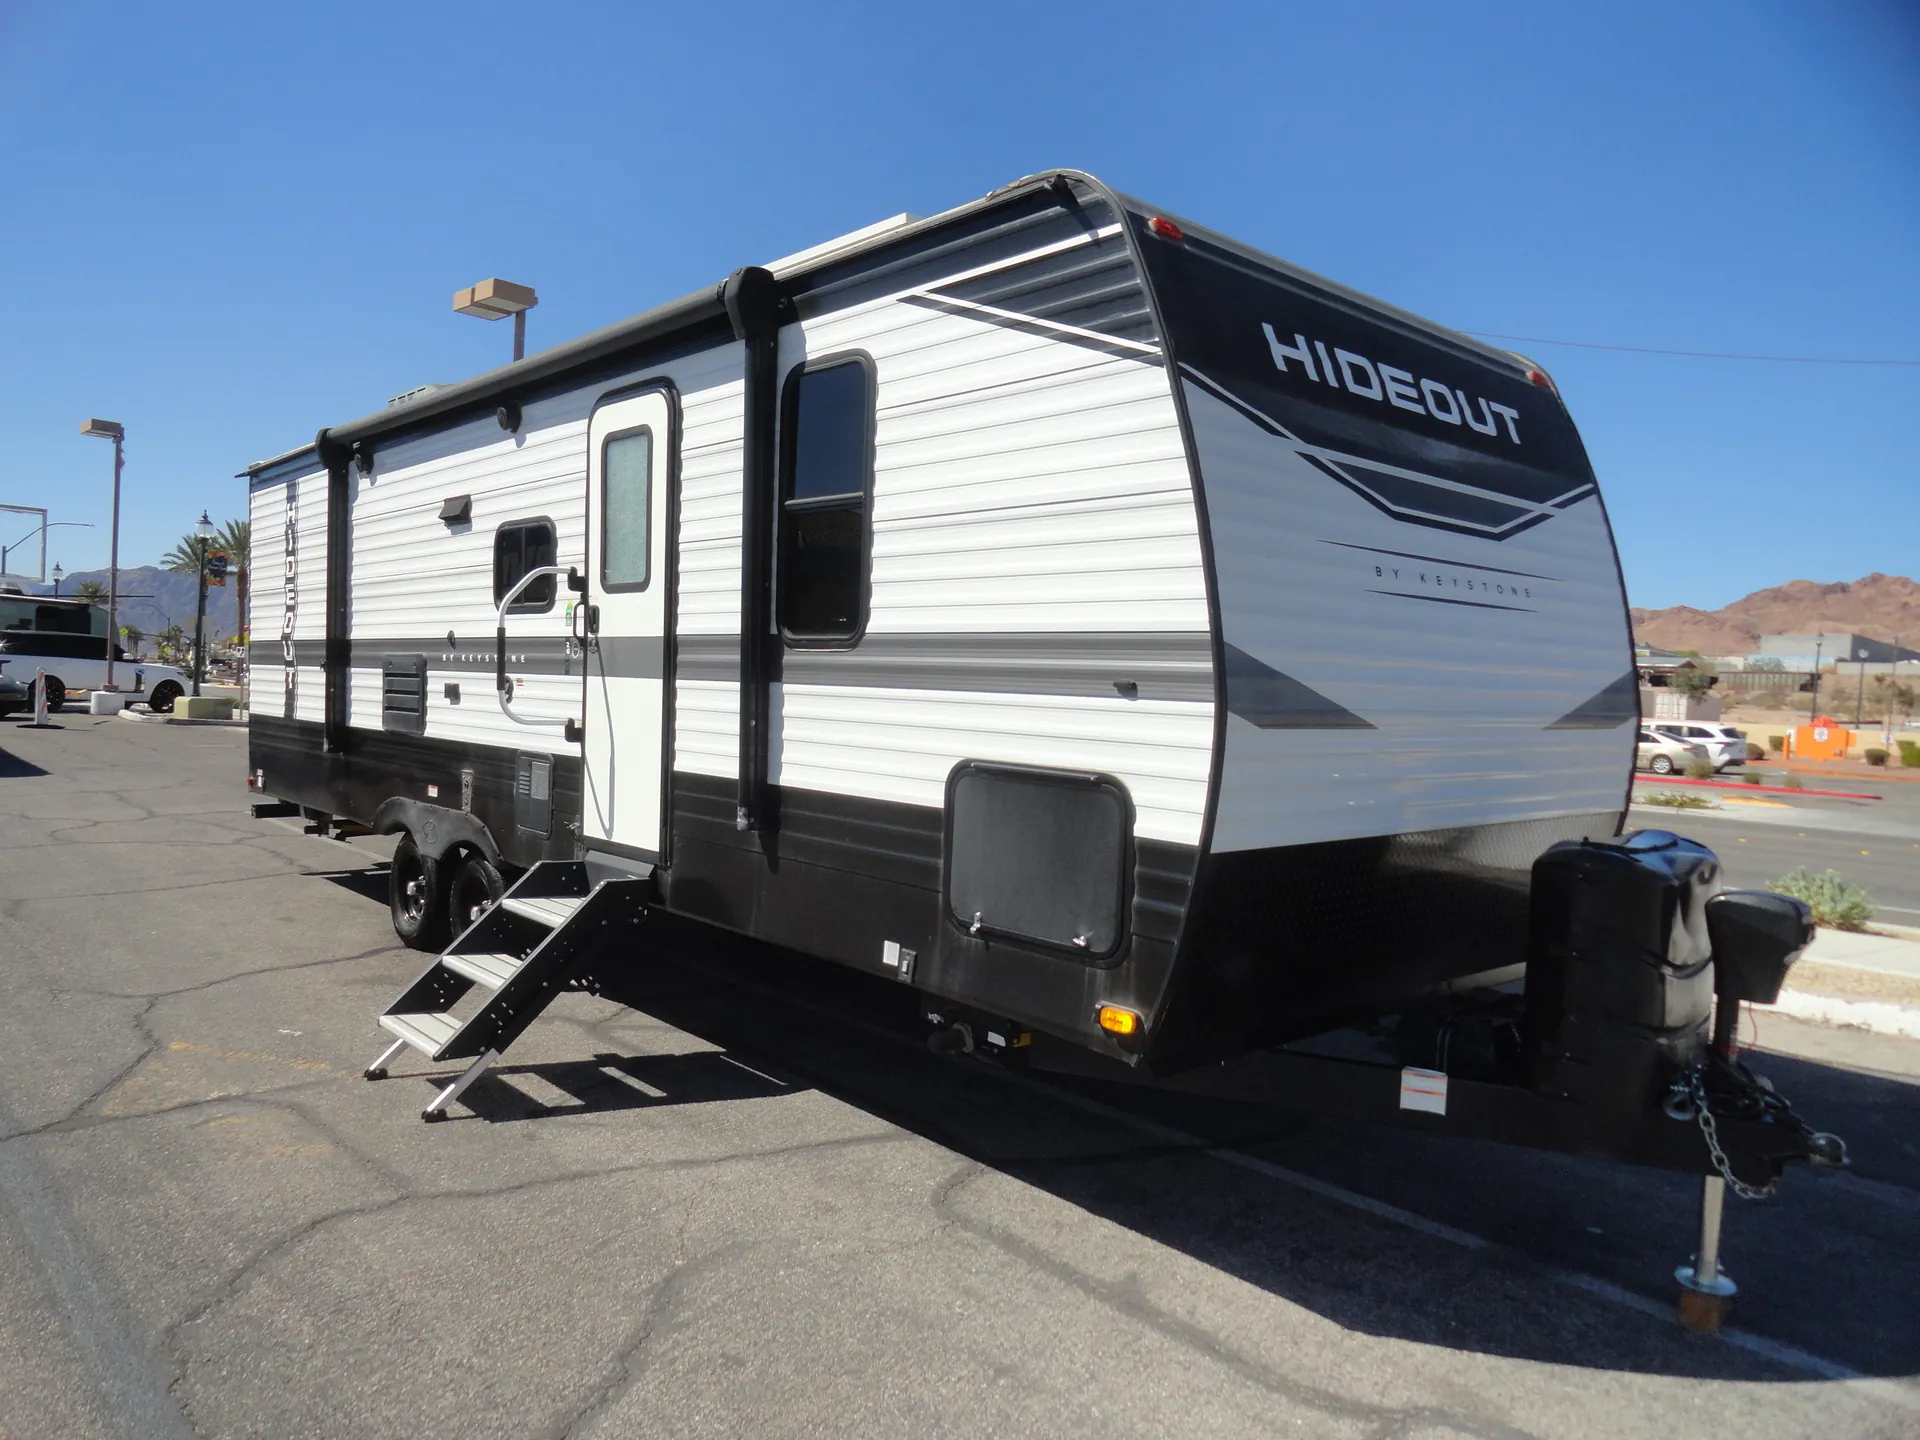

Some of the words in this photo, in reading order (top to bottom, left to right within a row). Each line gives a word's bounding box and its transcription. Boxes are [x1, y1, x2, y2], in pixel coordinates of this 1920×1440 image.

[1261, 322, 1522, 445] HIDEOUT
[282, 501, 297, 690] HIDEOUT
[1375, 566, 1399, 580] BY
[1420, 572, 1532, 598] KEYSTONE
[442, 653, 455, 662] BY
